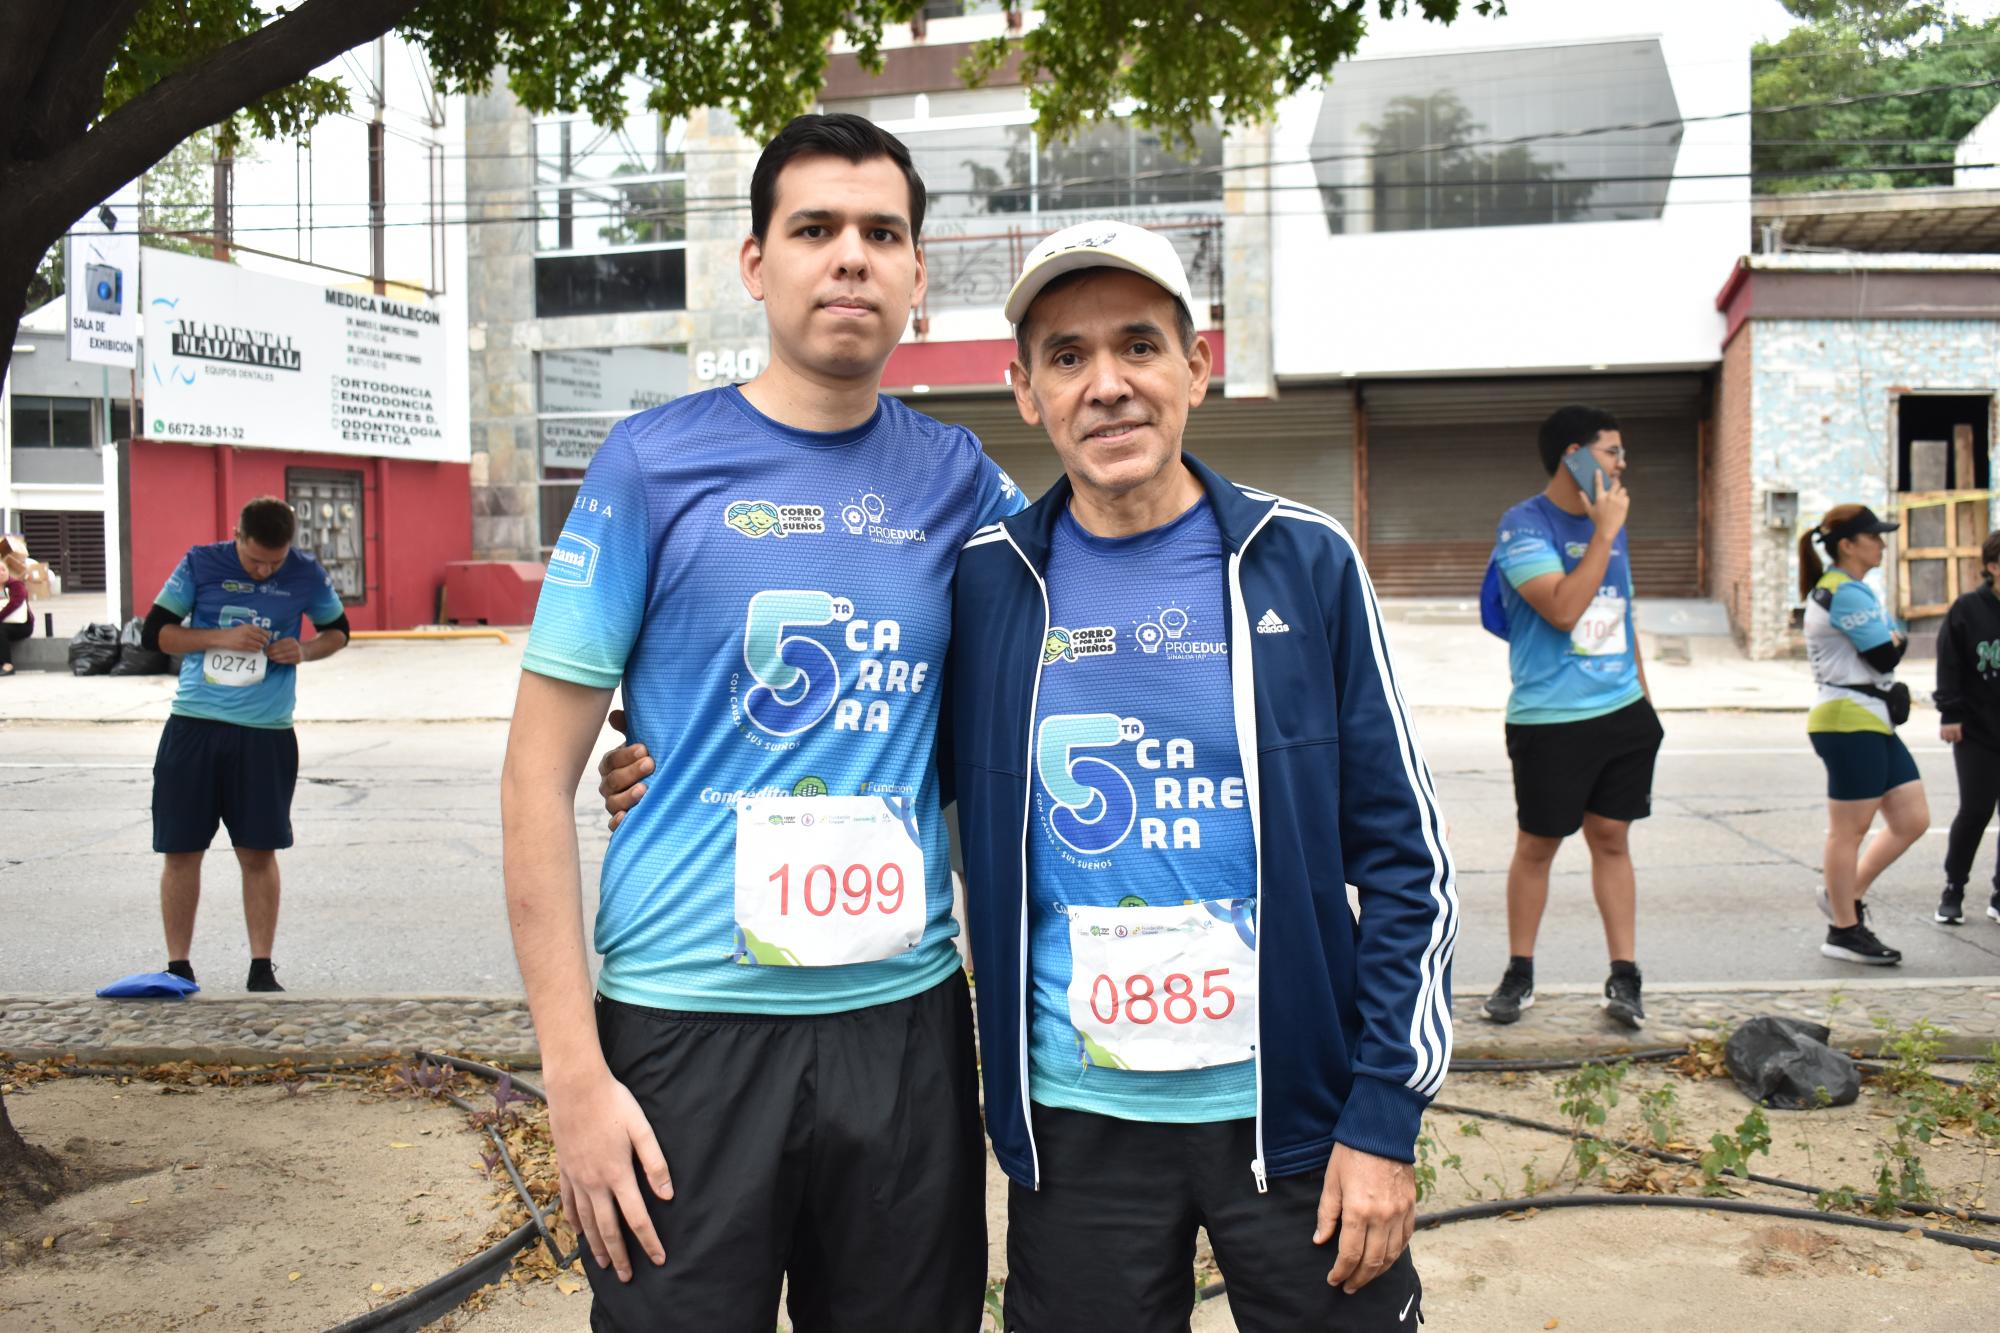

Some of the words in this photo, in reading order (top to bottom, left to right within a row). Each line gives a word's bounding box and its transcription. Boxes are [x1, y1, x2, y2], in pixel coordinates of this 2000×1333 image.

[325, 289, 376, 313] MEDICA
[381, 302, 441, 325] MALECON
[73, 317, 94, 331] SALA
[95, 321, 105, 332] DE
[178, 319, 294, 351] MADENTAL
[177, 333, 299, 366] MADENTAL
[204, 365, 237, 378] EQUIPOS
[238, 368, 274, 382] DENTALES
[696, 348, 759, 380] 640
[340, 378, 432, 399] ORTODONCIA
[341, 392, 433, 411] ENDODONCIA
[341, 405, 421, 423] IMPLANTES
[167, 423, 245, 439] 6672-28-31-32
[341, 419, 442, 438] ODONTOLOGIA
[342, 431, 412, 446] ESTETICA
[780, 507, 822, 517] CORRO
[782, 521, 822, 530] SUEÑOS
[868, 525, 926, 542] PROEDUCA
[845, 619, 901, 652] CA
[1072, 628, 1113, 640] CORRO
[1256, 624, 1290, 634] adidas
[1073, 643, 1114, 655] SUEÑOS
[211, 654, 257, 674] 0274
[730, 673, 739, 693] CON
[855, 659, 929, 693] RRE
[834, 700, 890, 732] RA
[745, 731, 762, 746] SUS
[1136, 738, 1195, 769] CA
[1036, 792, 1044, 813] CON
[1154, 777, 1244, 809] RRE
[1140, 817, 1201, 849] RA
[1061, 850, 1076, 864] SUS
[768, 862, 905, 917] 1099
[1089, 967, 1236, 1025] 0885
